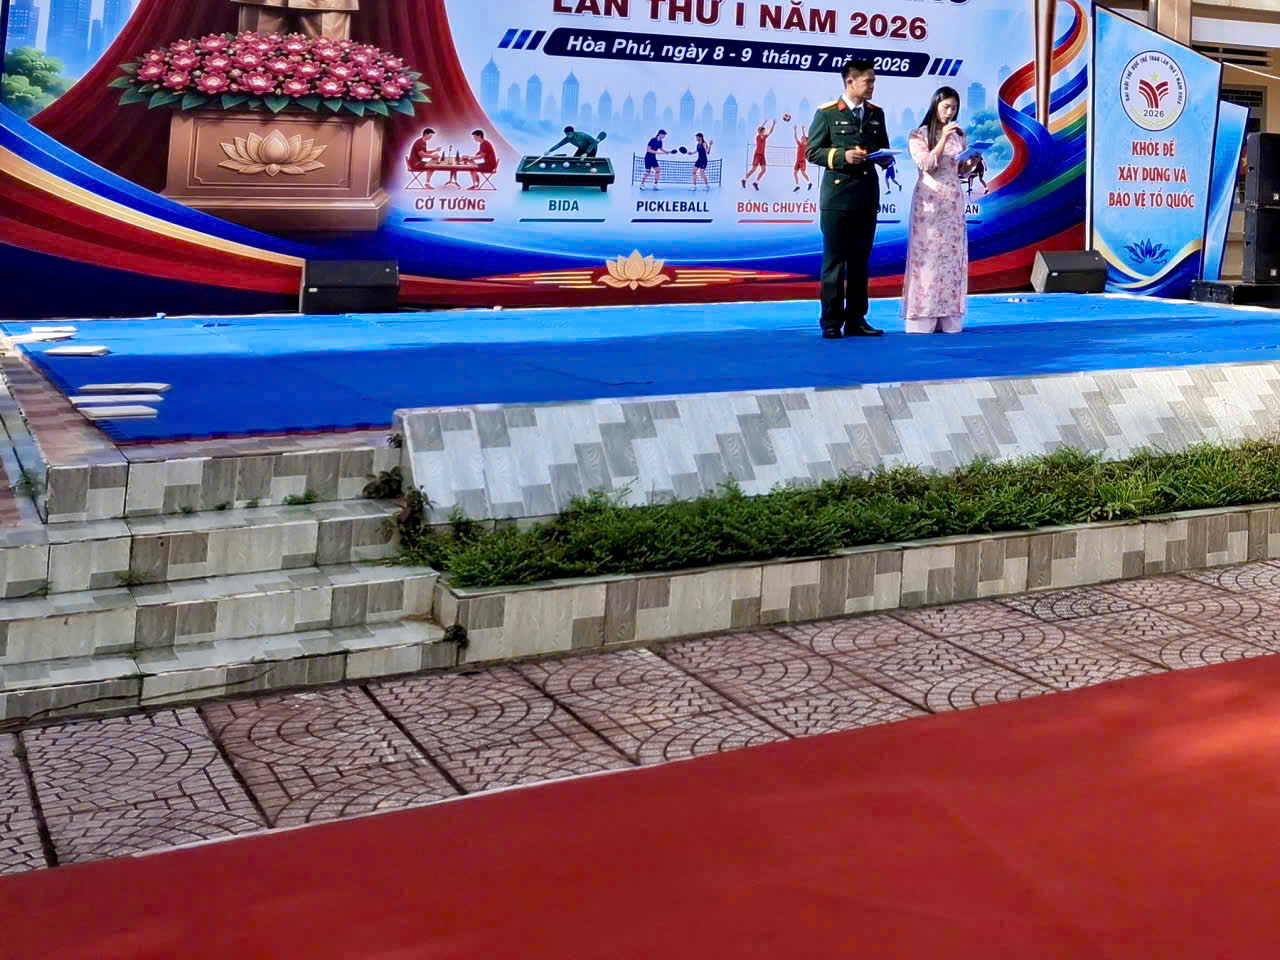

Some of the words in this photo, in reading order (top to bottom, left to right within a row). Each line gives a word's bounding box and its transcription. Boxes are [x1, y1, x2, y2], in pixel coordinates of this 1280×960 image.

[735, 2, 745, 27] I
[758, 0, 837, 35] NĂM
[849, 11, 927, 41] 2026
[567, 35, 606, 54] Hòa
[612, 38, 654, 58] Phú,
[662, 42, 708, 62] ngày
[713, 46, 725, 61] 8
[740, 48, 752, 62] 9
[762, 49, 812, 69] tháng
[817, 53, 828, 68] 7
[873, 56, 910, 72] 2026
[1143, 109, 1164, 118] 2026
[1119, 164, 1138, 181] XÂY
[1142, 167, 1170, 184] DỰNG
[415, 197, 435, 210] CỜ
[439, 197, 486, 210] TƯỚNG
[548, 200, 580, 212] BIDA
[1134, 190, 1146, 209] VỆ
[1166, 190, 1194, 208] QUỐC
[636, 201, 709, 213] PICKLEBALL
[737, 200, 768, 213] BÓNG
[965, 201, 979, 214] ÀN
